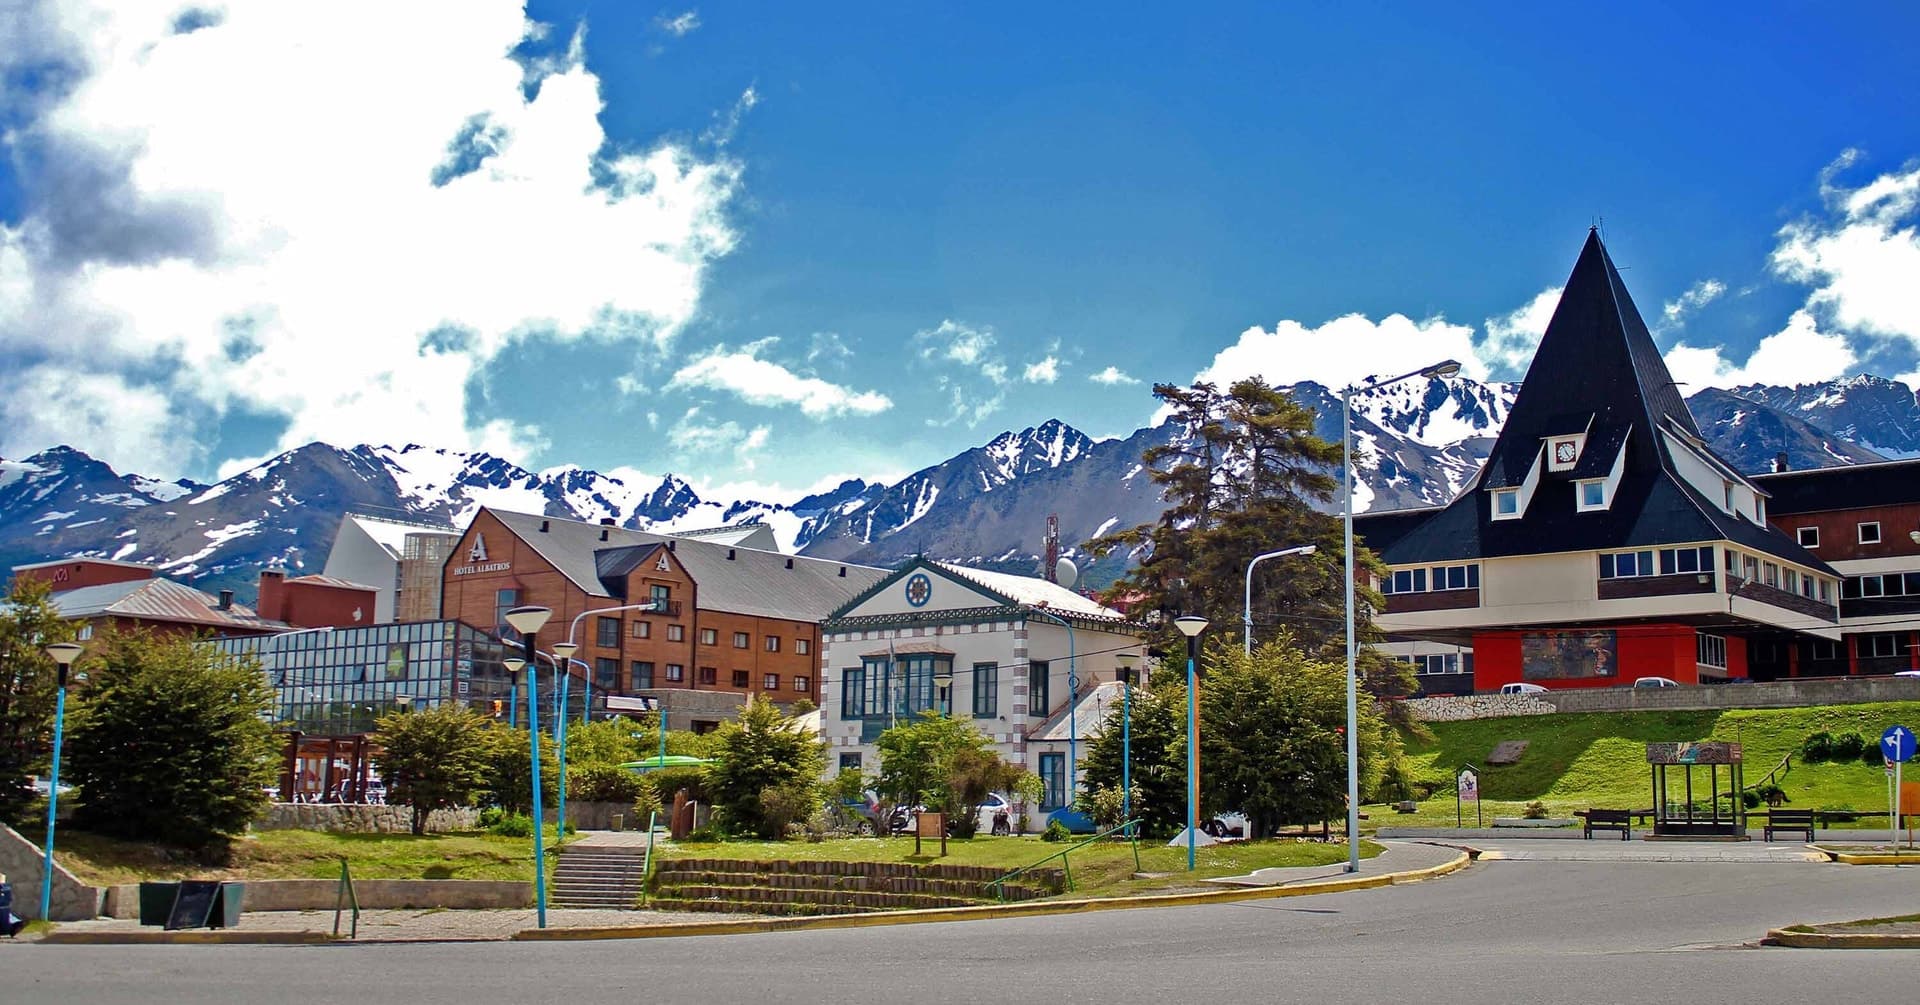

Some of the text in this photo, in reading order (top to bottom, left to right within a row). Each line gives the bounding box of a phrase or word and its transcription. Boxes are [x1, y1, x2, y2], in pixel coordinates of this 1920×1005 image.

[468, 532, 488, 562] A
[454, 562, 511, 576] HOTEL ALBATROS
[656, 552, 672, 572] A
